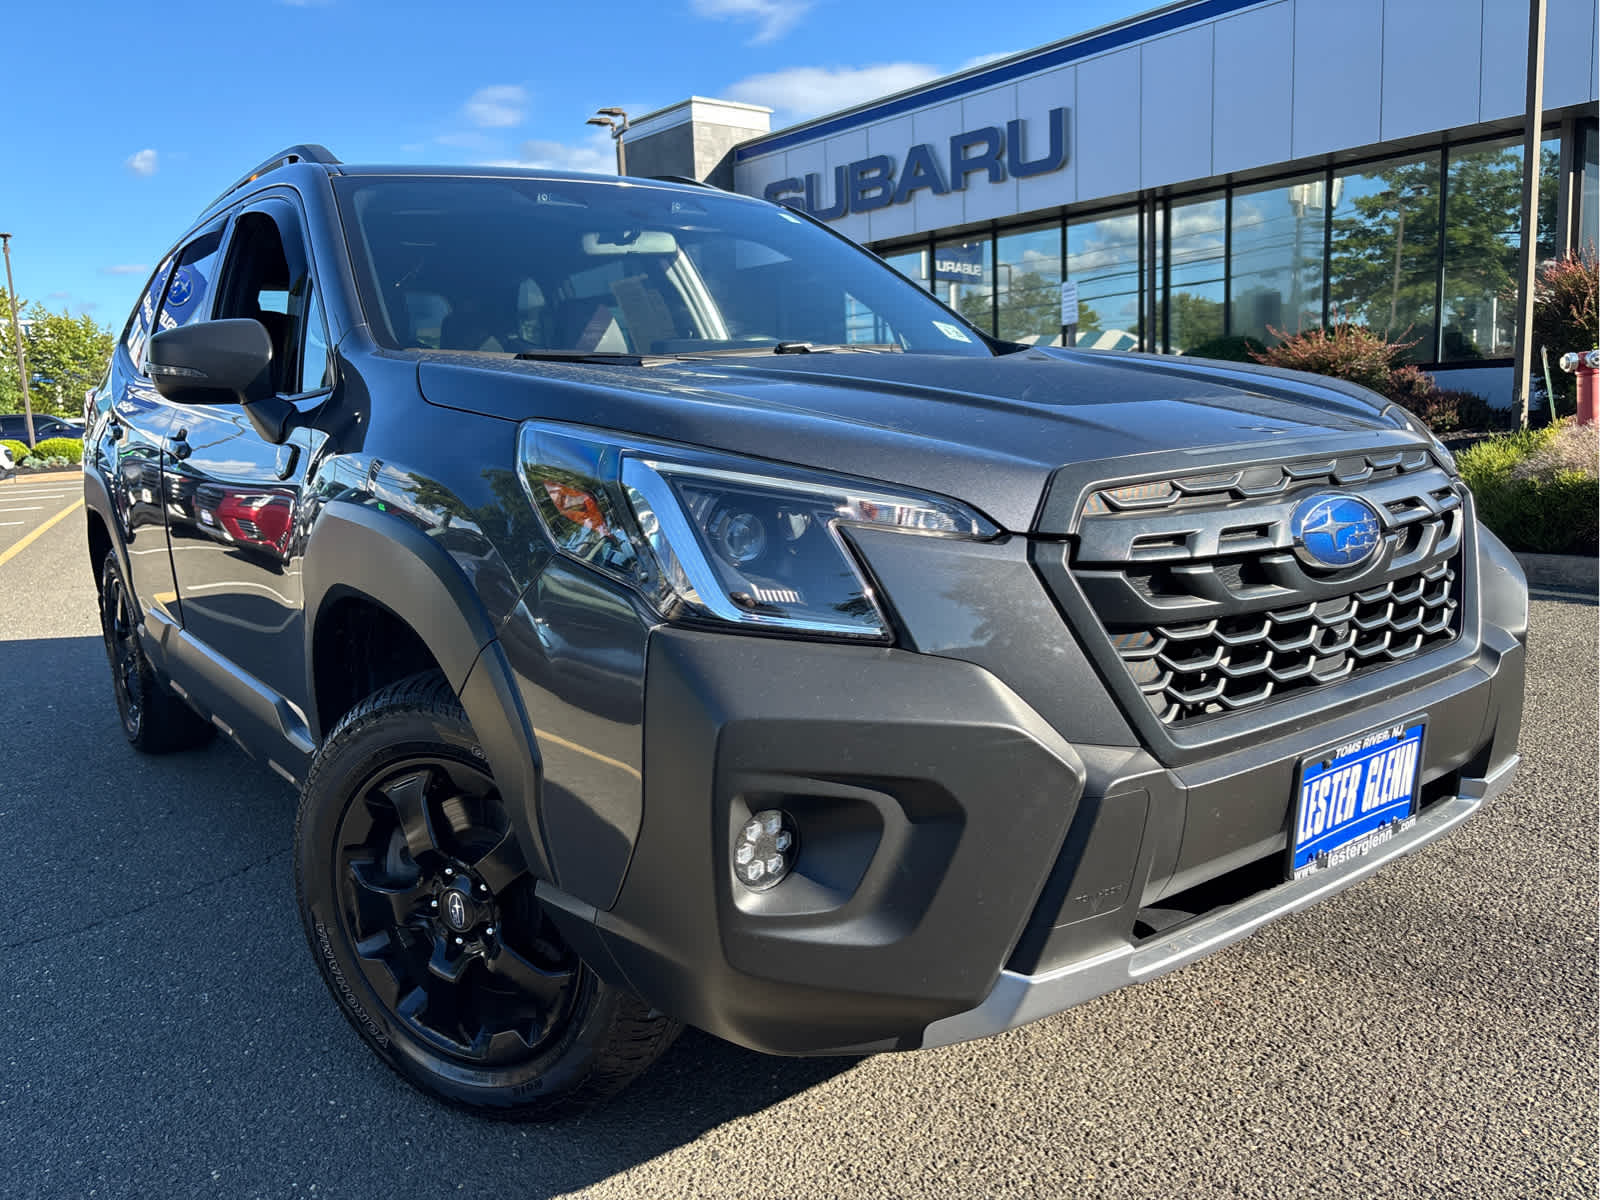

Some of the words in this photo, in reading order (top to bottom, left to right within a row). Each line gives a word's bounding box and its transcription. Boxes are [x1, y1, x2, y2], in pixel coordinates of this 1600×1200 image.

[764, 107, 1069, 222] SUBARU
[1296, 764, 1362, 845] LESTER
[1361, 741, 1419, 813] GLENN
[1336, 741, 1362, 759] TOMS
[1391, 724, 1404, 738] NJ
[315, 921, 390, 1048] YOKOHAMA
